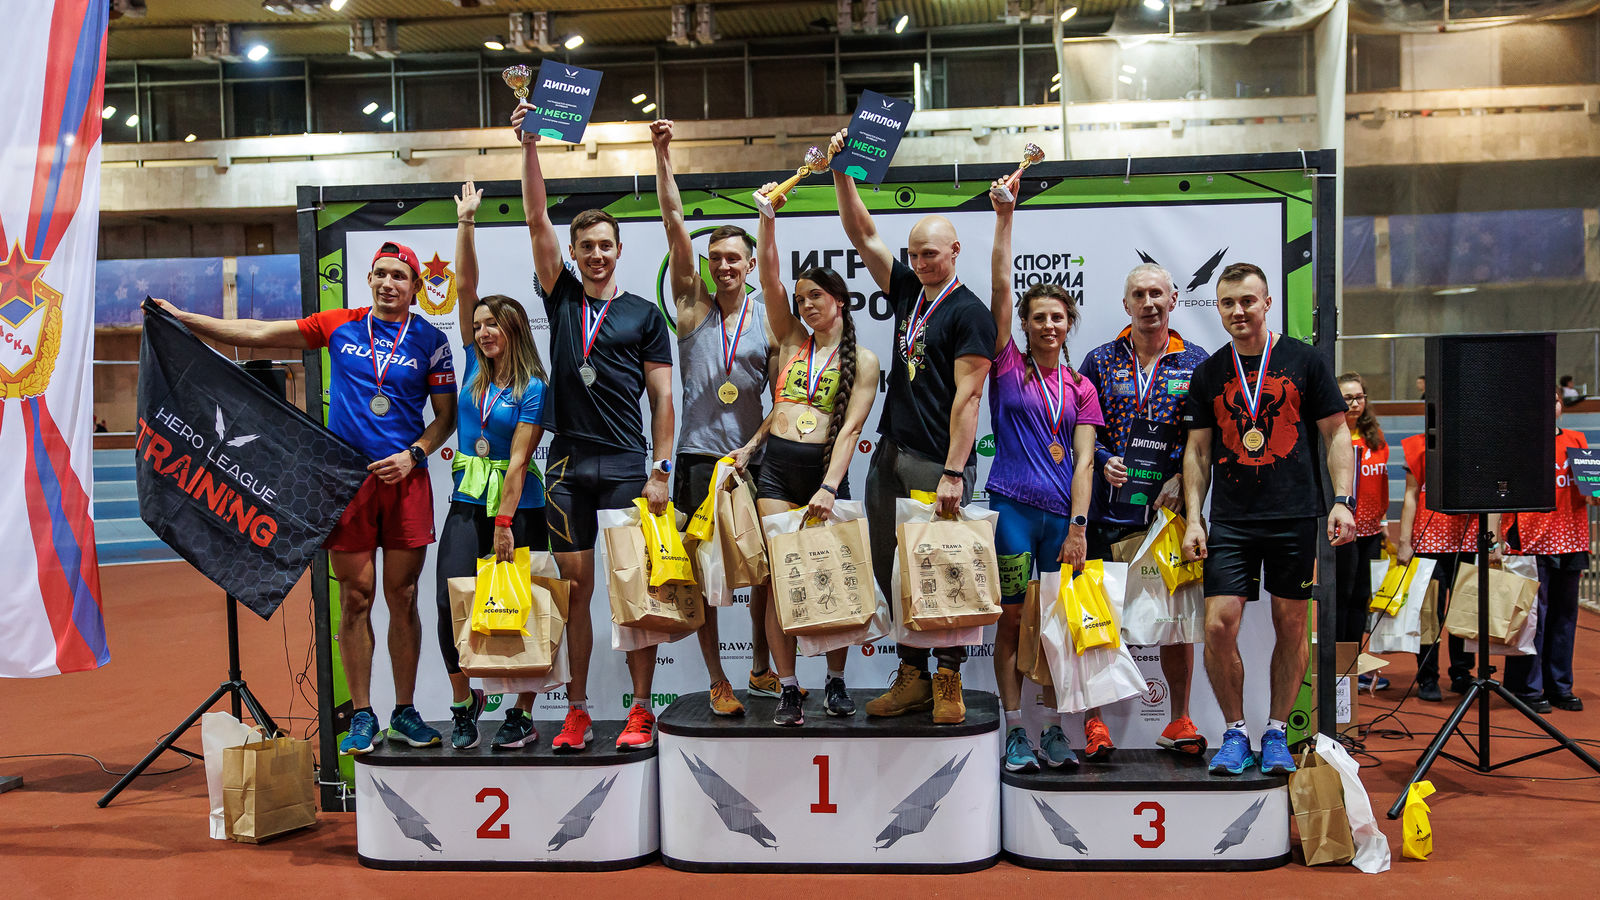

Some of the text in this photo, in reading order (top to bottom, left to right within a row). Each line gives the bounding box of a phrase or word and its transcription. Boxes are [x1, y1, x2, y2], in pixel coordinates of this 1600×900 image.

[543, 79, 591, 97] ДИПЛОМ
[544, 108, 583, 122] МЕСТО
[859, 110, 901, 131] ДИПЛОМ
[853, 141, 887, 158] МЕСТО
[1014, 253, 1072, 271] СПОРТ
[1014, 271, 1084, 290] НОРМА
[427, 285, 446, 299] ЦСКА
[341, 343, 419, 370] RUSSIA
[435, 373, 456, 384] TE
[1131, 438, 1168, 451] ДИПЛОМ
[155, 407, 277, 504] HERO LEAGUE
[136, 416, 278, 547] TRAINING
[1134, 469, 1163, 480] МЕСТО
[720, 642, 754, 651] RAWA
[487, 695, 502, 704] КО
[810, 755, 837, 814] 1
[475, 787, 510, 839] 2
[1133, 801, 1166, 848] 3
